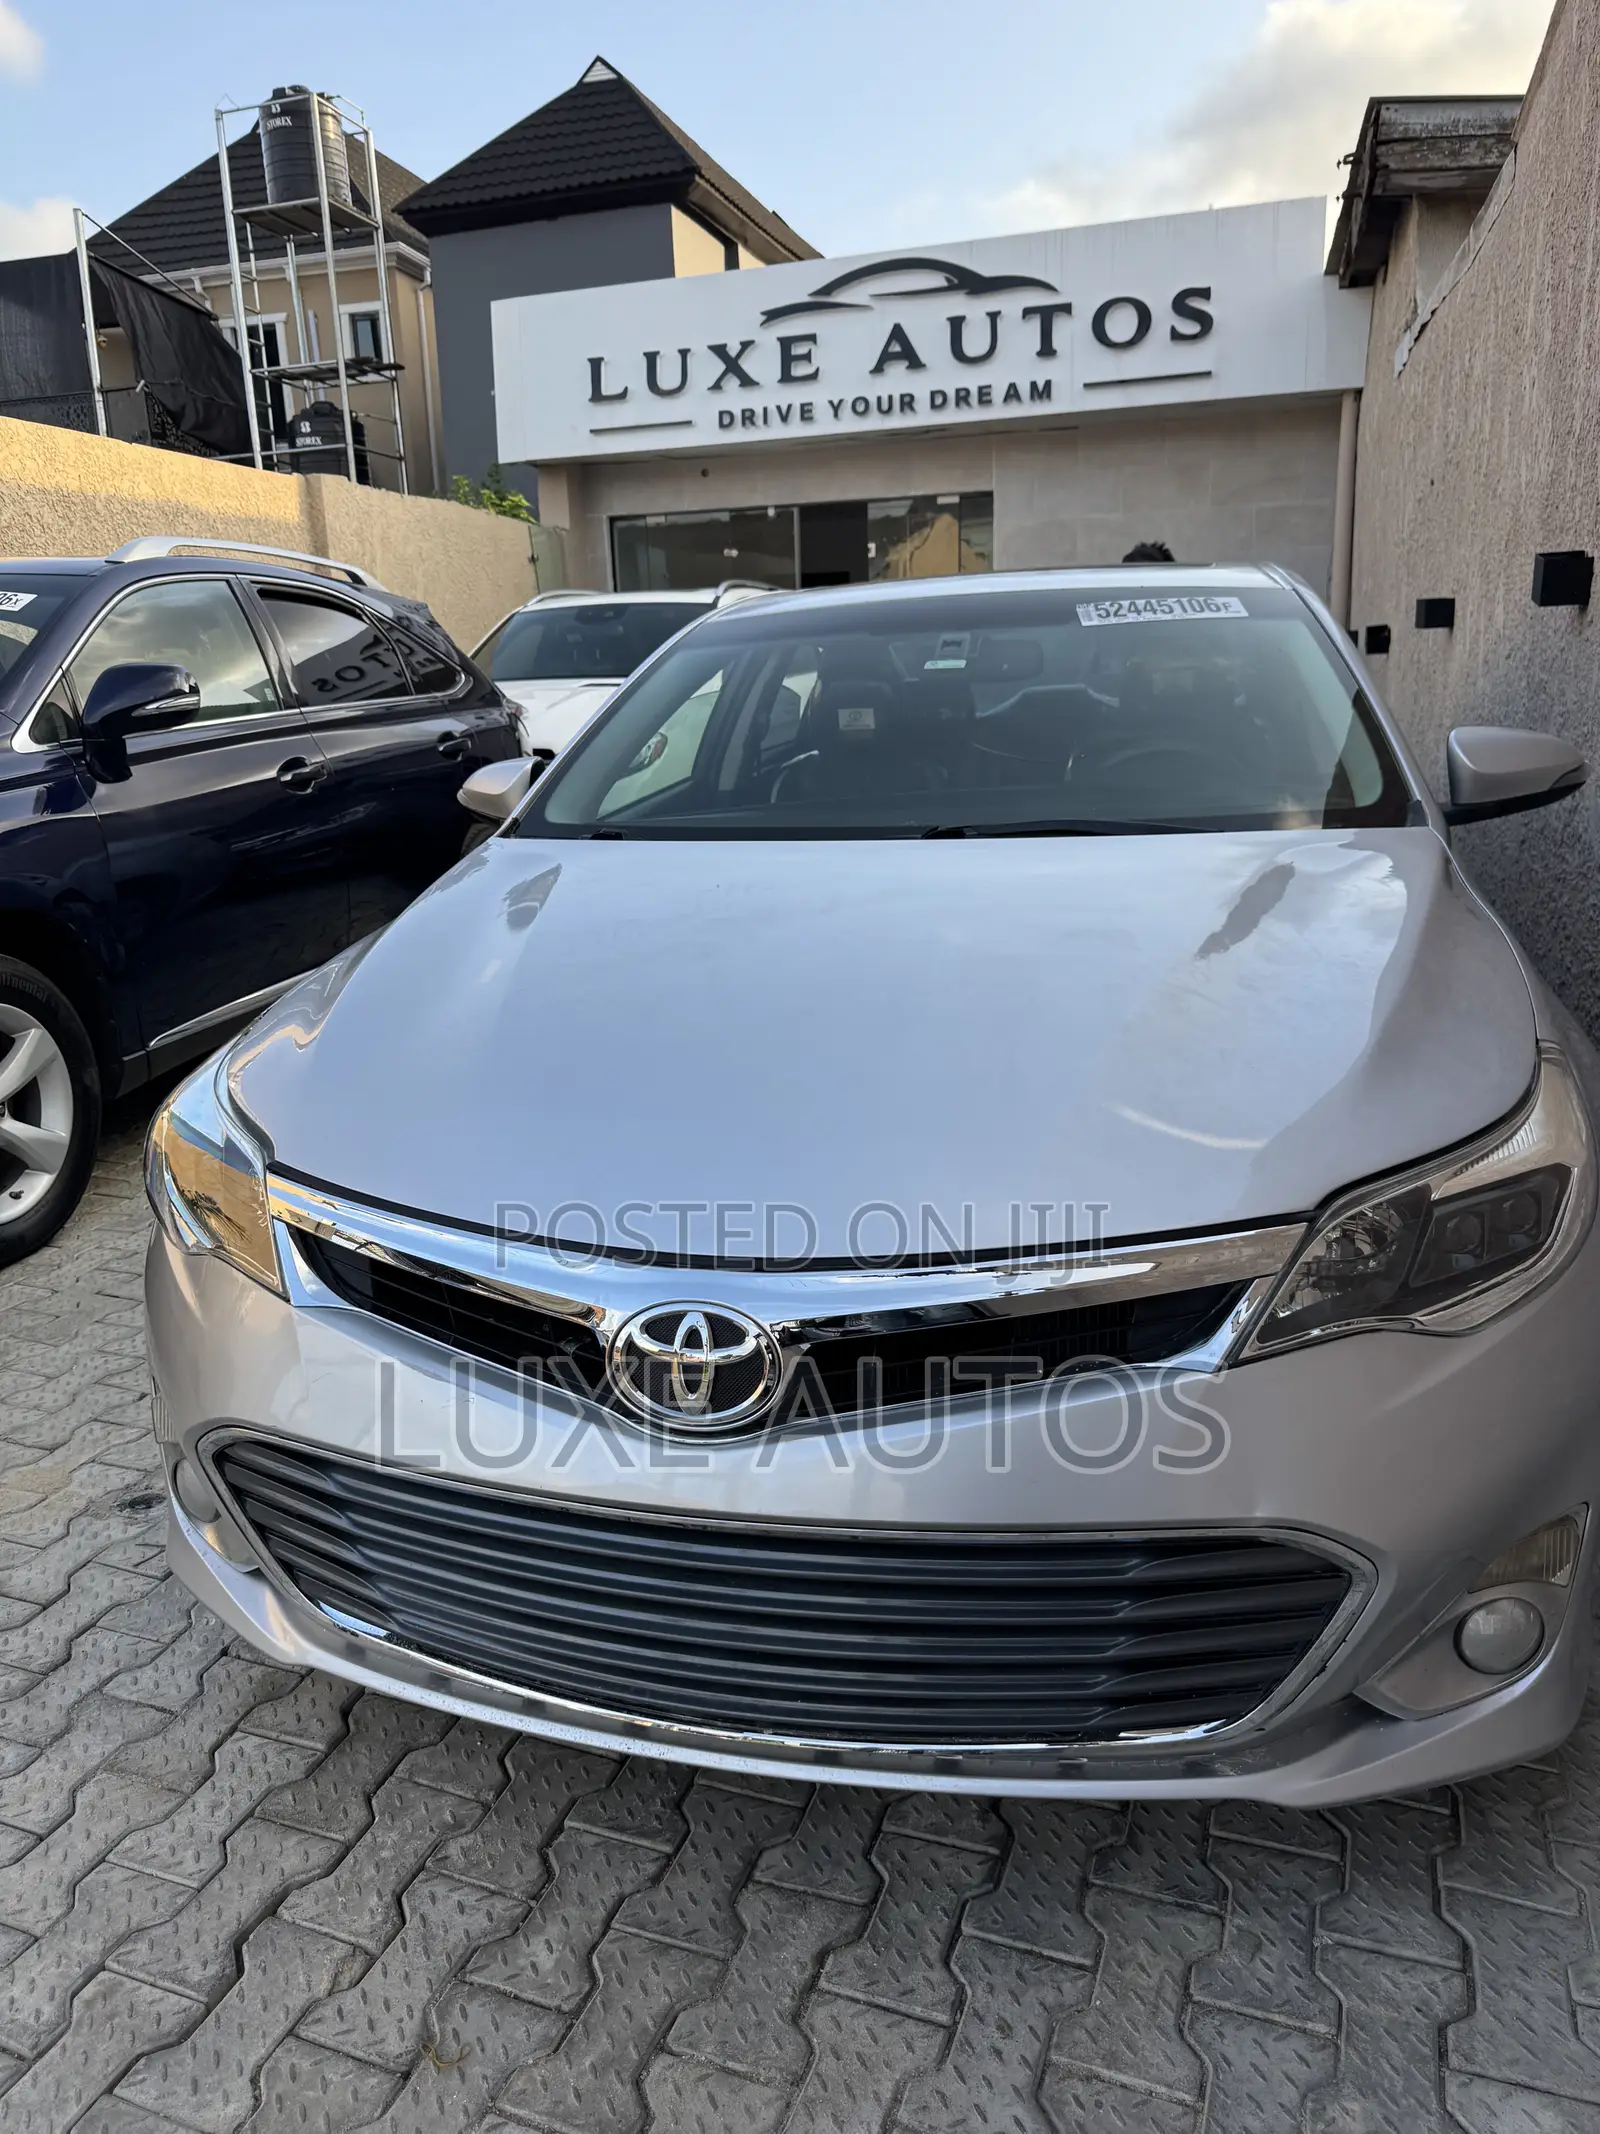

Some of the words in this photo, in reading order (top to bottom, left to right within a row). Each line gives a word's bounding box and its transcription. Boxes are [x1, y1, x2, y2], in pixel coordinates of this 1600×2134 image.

[266, 116, 293, 131] STOREX
[587, 333, 820, 402] LUXE
[868, 286, 1214, 374] AUTOS
[718, 402, 814, 429] DRIVE
[828, 393, 916, 419] YOUR
[930, 379, 1052, 410] DREAM
